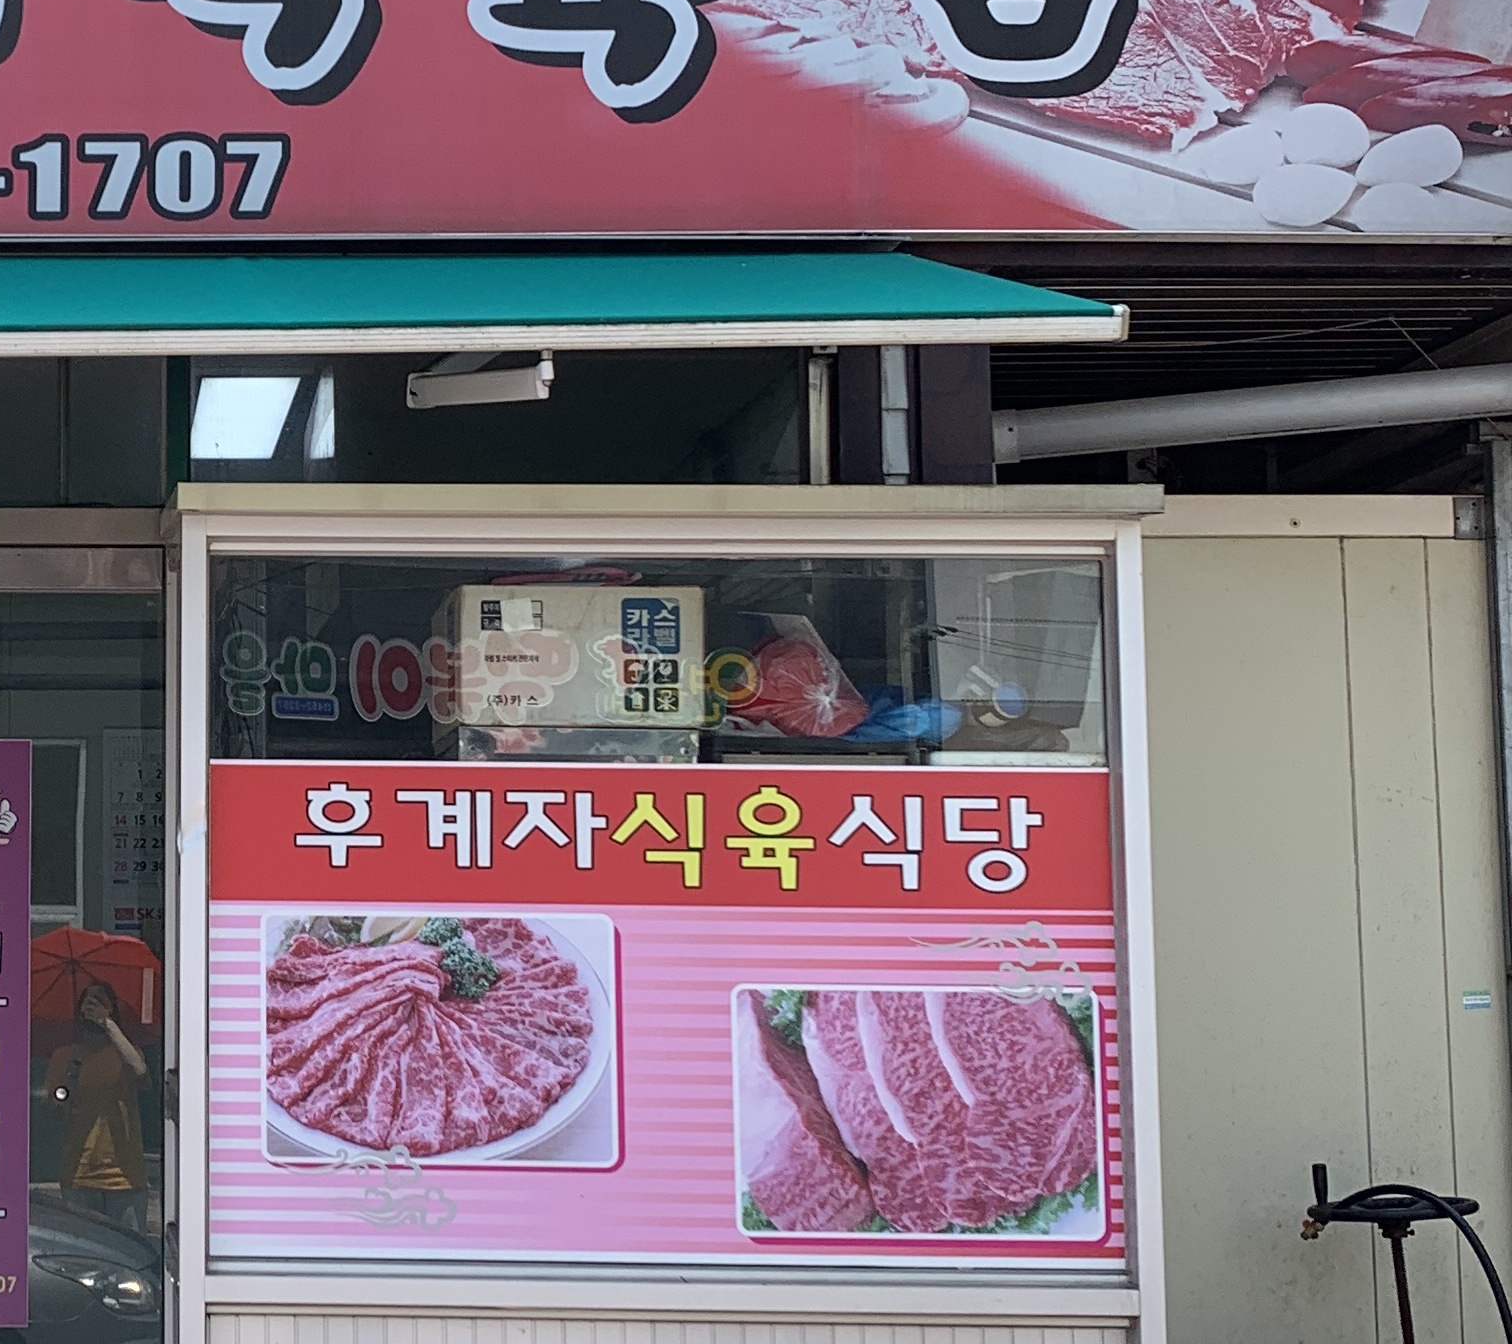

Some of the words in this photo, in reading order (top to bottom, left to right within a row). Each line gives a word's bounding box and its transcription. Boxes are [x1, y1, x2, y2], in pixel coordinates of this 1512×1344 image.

[626, 608, 677, 627] 카스
[626, 627, 677, 648] 라벨
[134, 815, 146, 825] 15
[133, 838, 147, 848] 22
[294, 782, 1044, 893] 후계자식육식당
[133, 860, 147, 872] 29
[137, 908, 154, 920] SK
